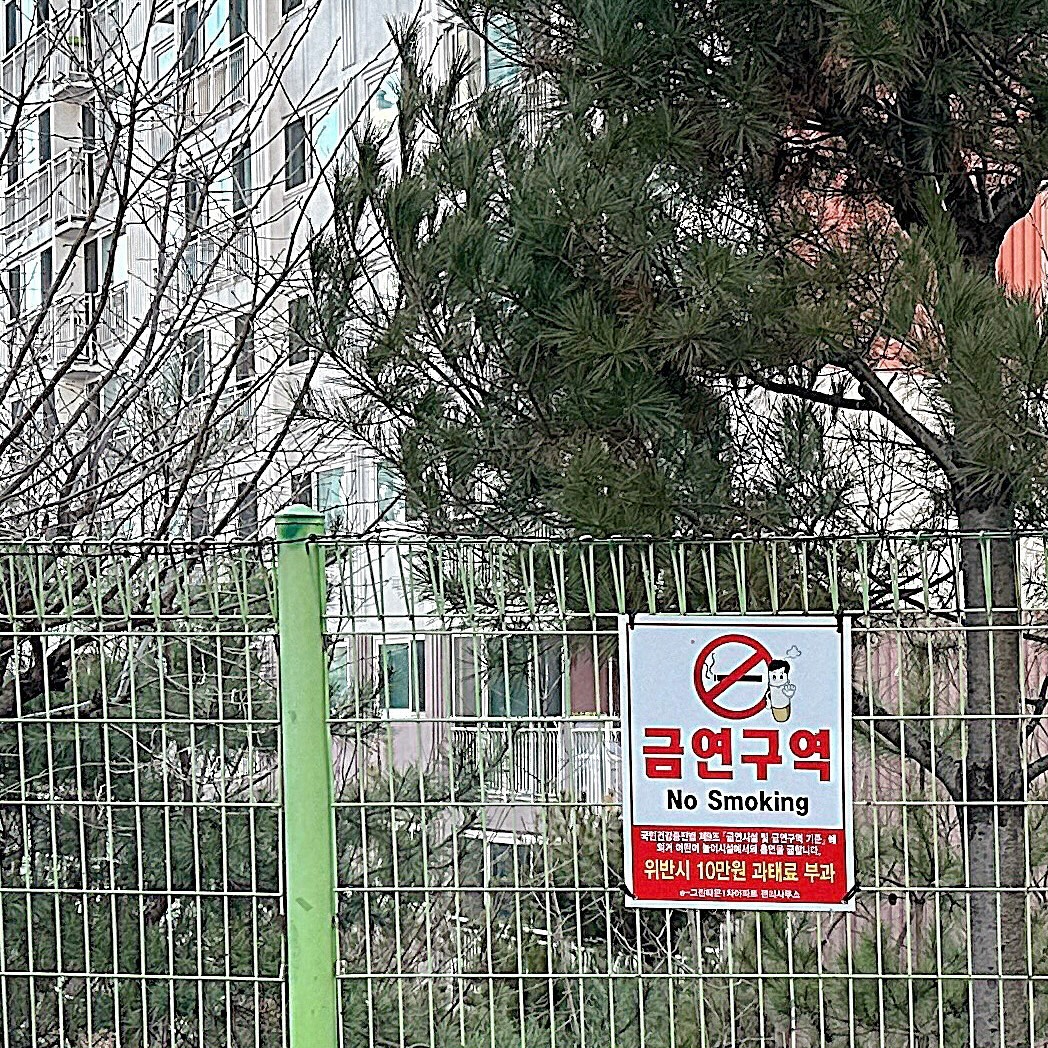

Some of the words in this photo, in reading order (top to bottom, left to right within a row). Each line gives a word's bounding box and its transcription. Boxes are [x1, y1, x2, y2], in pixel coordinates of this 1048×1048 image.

[642, 727, 831, 782] 금연구역
[667, 789, 698, 810] No
[708, 790, 809, 816] Smoking
[675, 843, 700, 854] 어린이
[771, 832, 804, 845] 금연구역
[644, 859, 690, 881] 위반시
[696, 860, 747, 882] 10만원
[751, 861, 799, 883] 과태료
[803, 862, 836, 884] 부과
